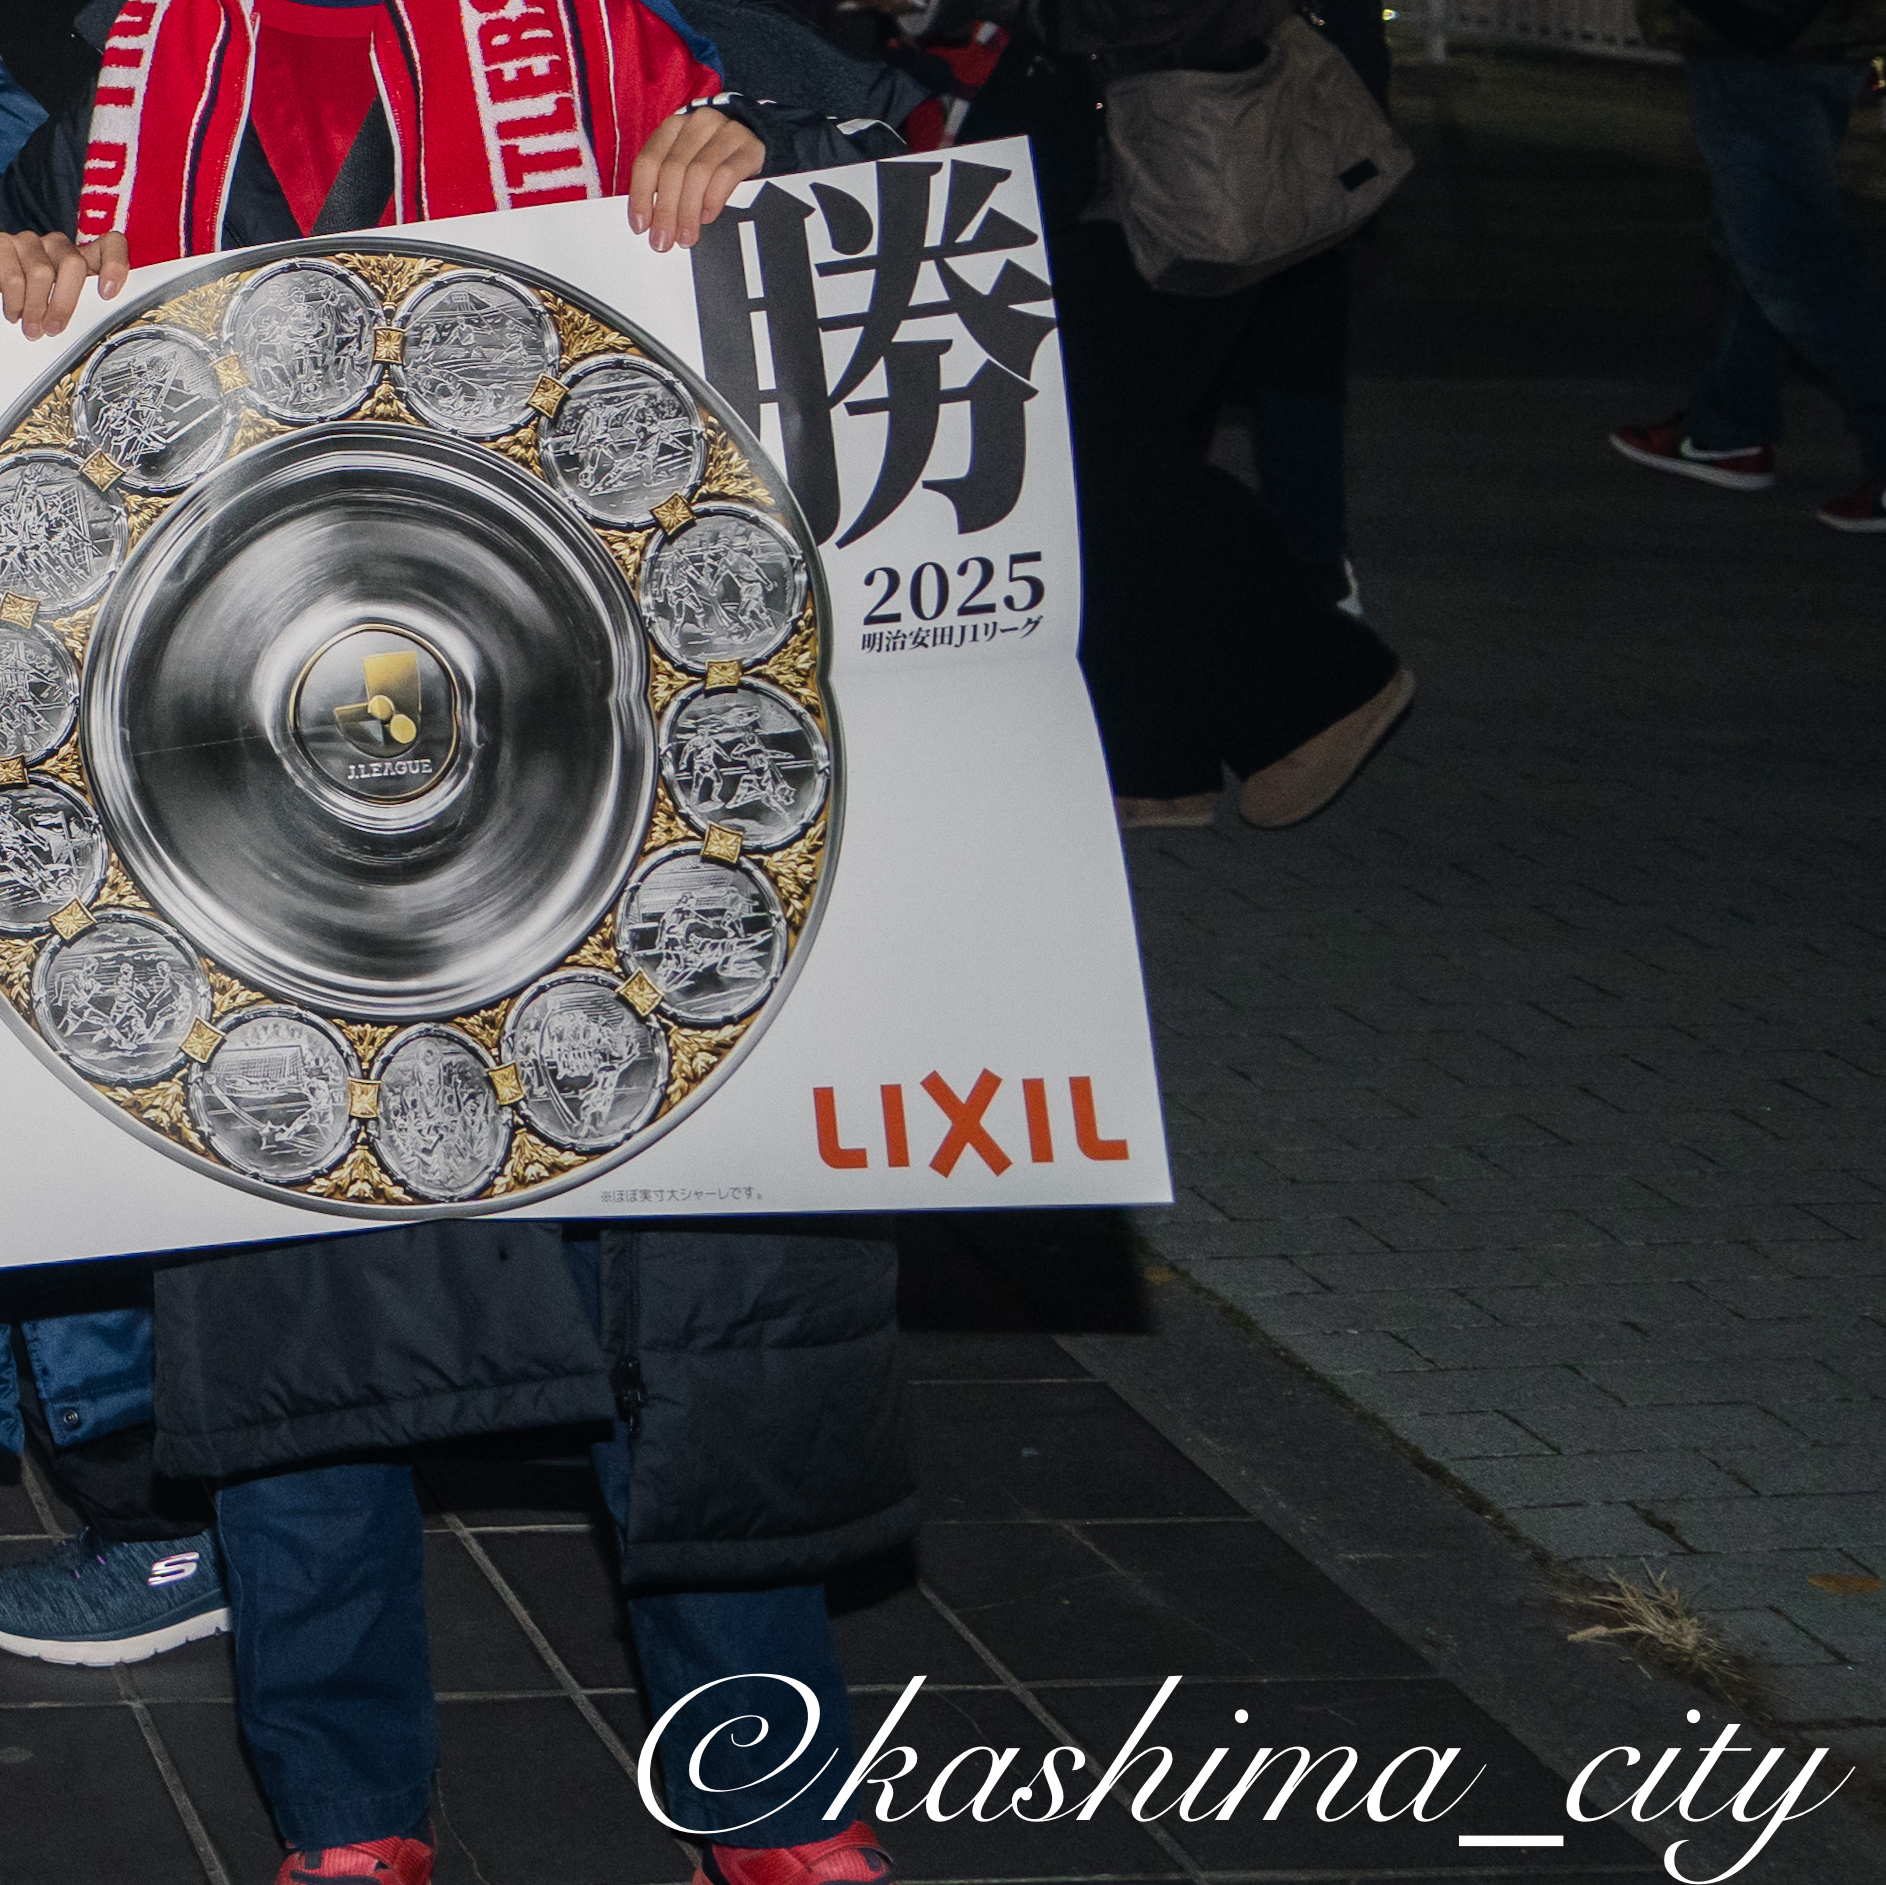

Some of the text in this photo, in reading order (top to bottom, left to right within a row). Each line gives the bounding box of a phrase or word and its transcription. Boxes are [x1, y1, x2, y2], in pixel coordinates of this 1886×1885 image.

[690, 159, 1058, 551] 勝
[863, 550, 1046, 626] 2025
[861, 614, 1045, 654] 明治安田J1リーグ
[346, 757, 433, 781] J.LEAGUE
[812, 1066, 1130, 1179] LIXIL
[600, 1186, 764, 1203] ※ほぼ実寸大シャーレです。
